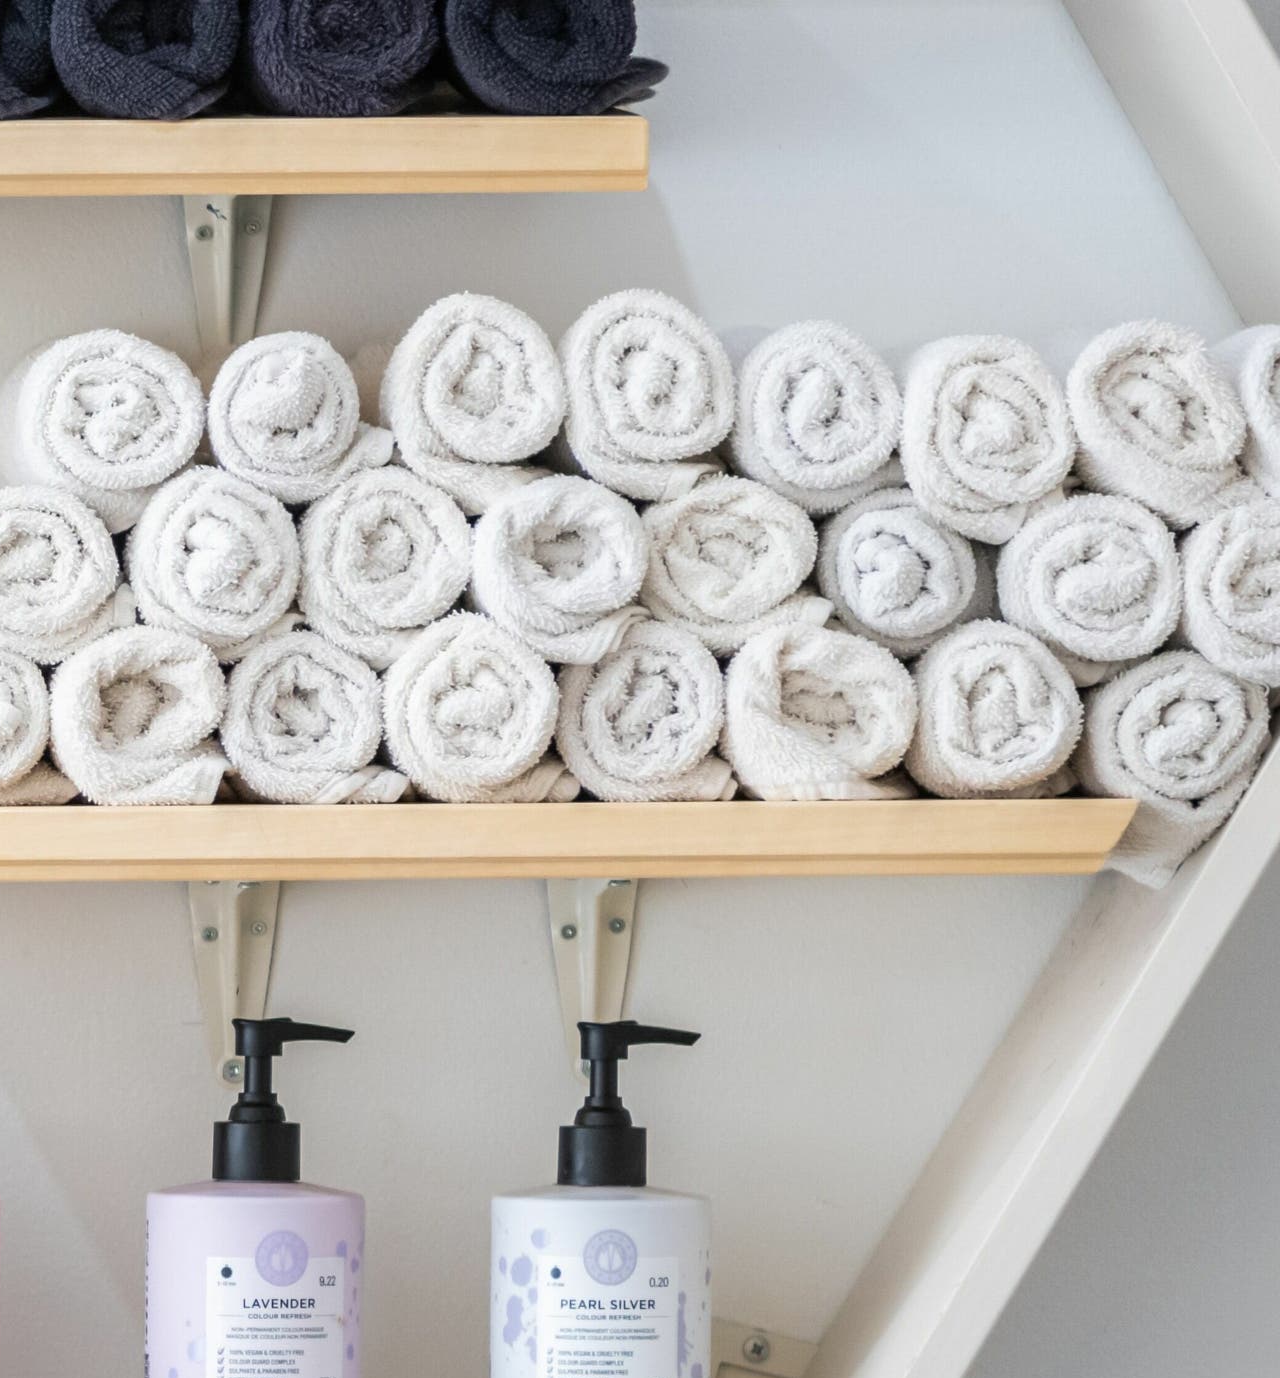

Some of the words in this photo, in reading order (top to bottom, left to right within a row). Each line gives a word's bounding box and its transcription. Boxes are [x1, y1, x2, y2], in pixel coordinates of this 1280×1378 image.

[319, 1276, 336, 1286] 9.22
[649, 1277, 669, 1287] 0.20
[243, 1299, 315, 1309] LAVENDER
[561, 1300, 605, 1309] PEARL
[610, 1300, 656, 1309] SILVER
